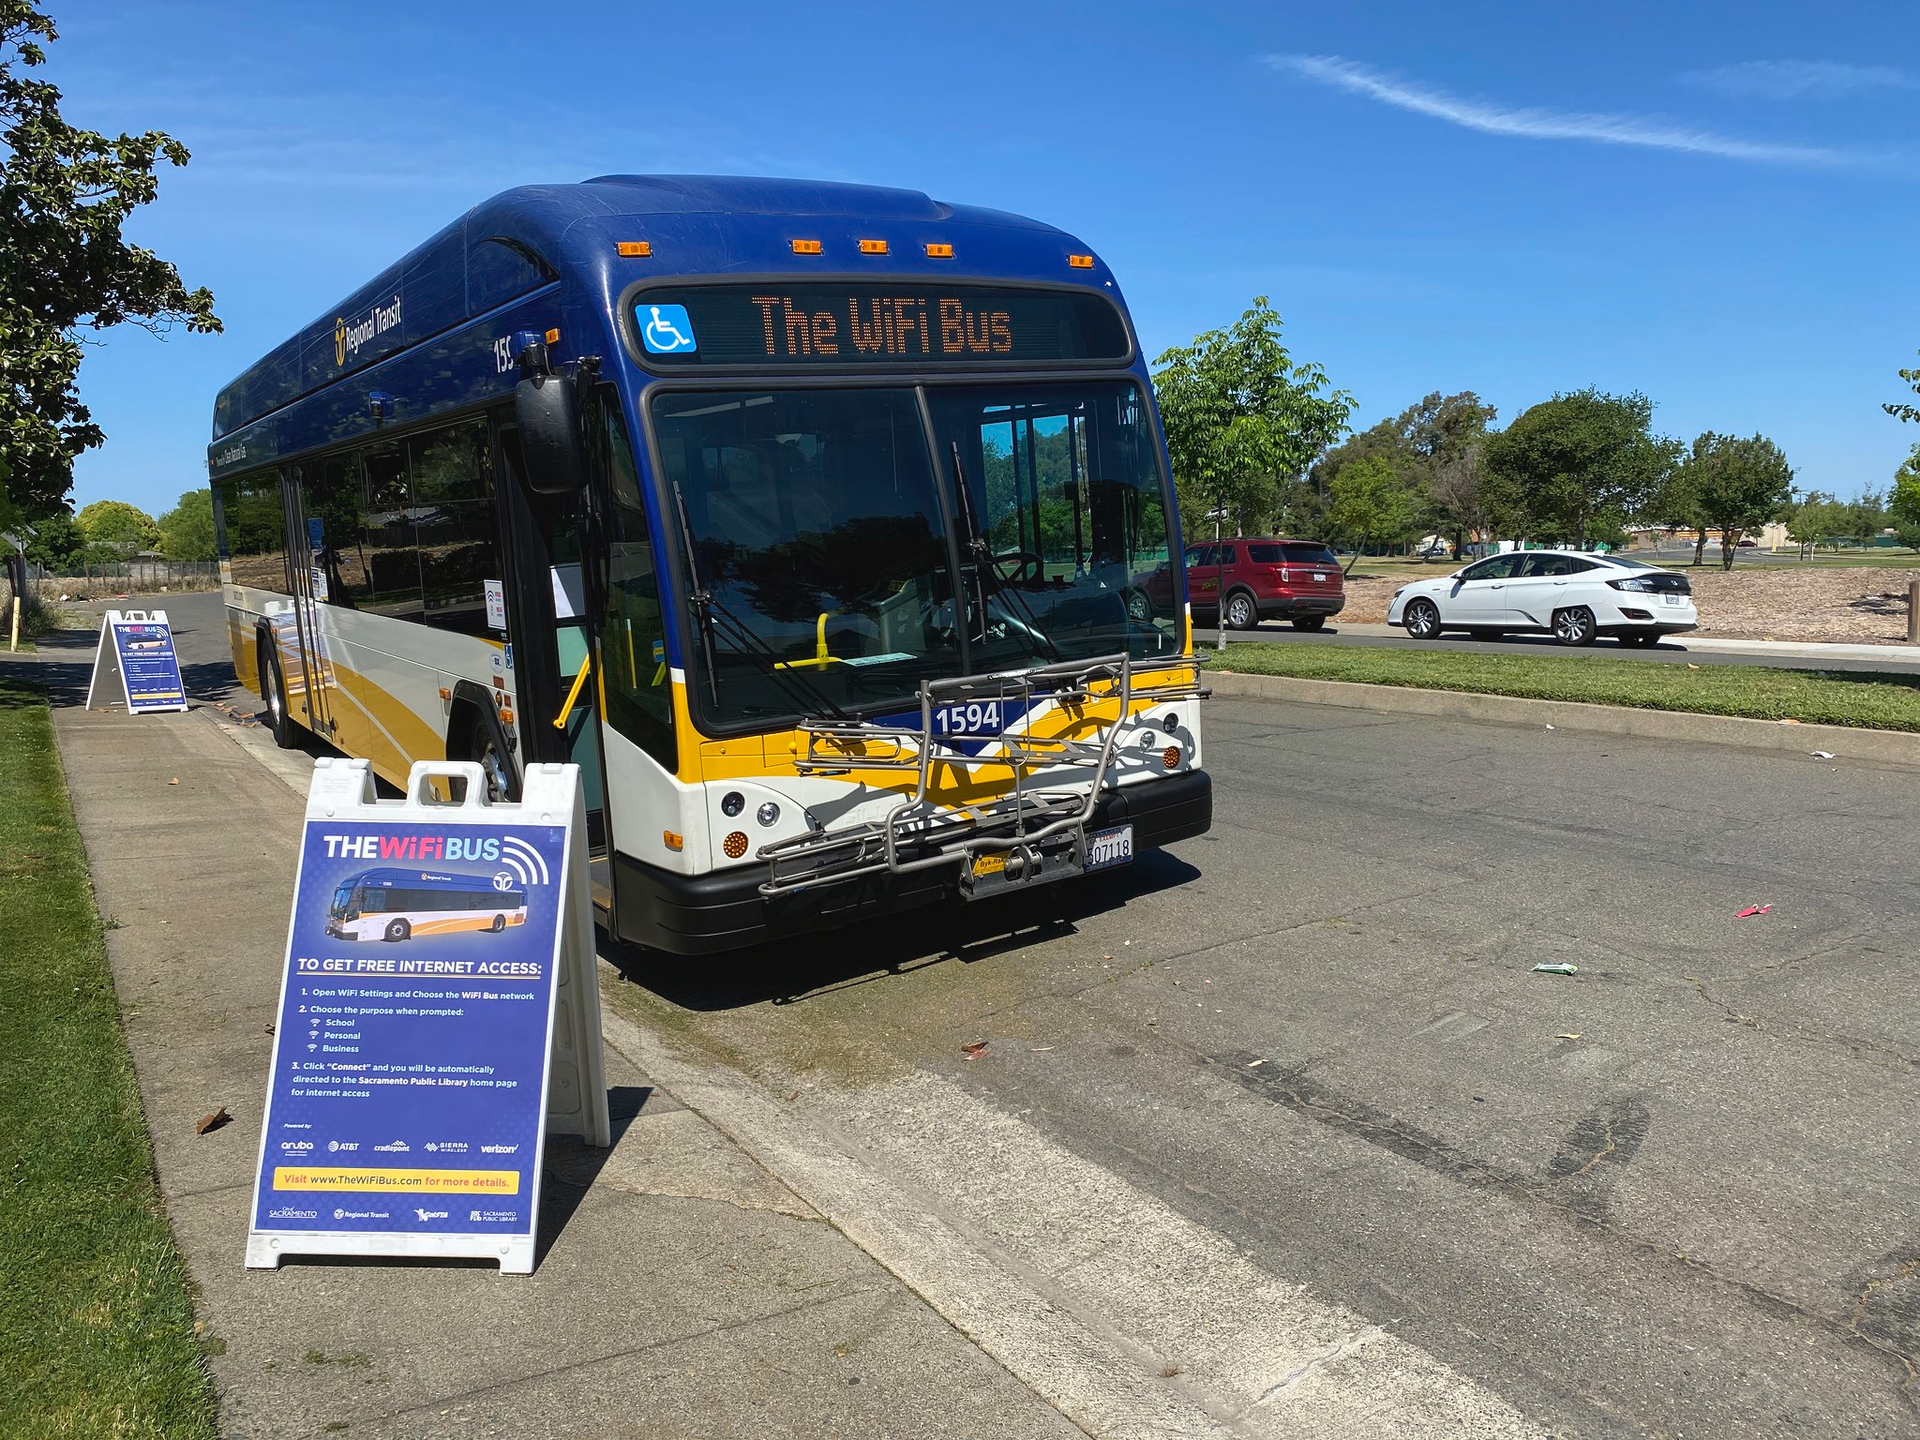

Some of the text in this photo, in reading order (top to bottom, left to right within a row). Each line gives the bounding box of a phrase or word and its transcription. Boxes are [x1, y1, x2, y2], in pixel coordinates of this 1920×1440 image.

[345, 295, 401, 354] Regional Transit
[751, 296, 1012, 355] The WiFi Bus
[936, 701, 1000, 734] 1594
[298, 958, 542, 975] TO GET FREE INTERNET ACCESS:
[312, 989, 335, 998] Open
[338, 989, 358, 997] WiFi
[359, 989, 393, 998] Settings
[395, 990, 411, 998] and
[445, 991, 459, 999] the
[500, 992, 535, 1000] network
[299, 1005, 464, 1017] 2. Choose the purpose when prompted:
[325, 1018, 355, 1026] School
[324, 1032, 361, 1040] Personal
[322, 1045, 359, 1053] Business
[303, 1062, 325, 1070] Click
[390, 1065, 407, 1073] you
[408, 1064, 423, 1072] will
[425, 1065, 436, 1073] be
[437, 1065, 494, 1075] automatically
[293, 1075, 518, 1088] directed to the Sacramento Public Library home page
[291, 1088, 304, 1096] for
[306, 1089, 341, 1097] internet
[281, 1141, 314, 1149] aruba
[339, 1143, 360, 1151] AT&T
[374, 1144, 410, 1152] cradlepoint
[481, 1144, 519, 1154] verizon
[284, 1174, 509, 1187] Visit www.TheWiFiBus.com for more details.
[345, 1211, 370, 1219] Regional
